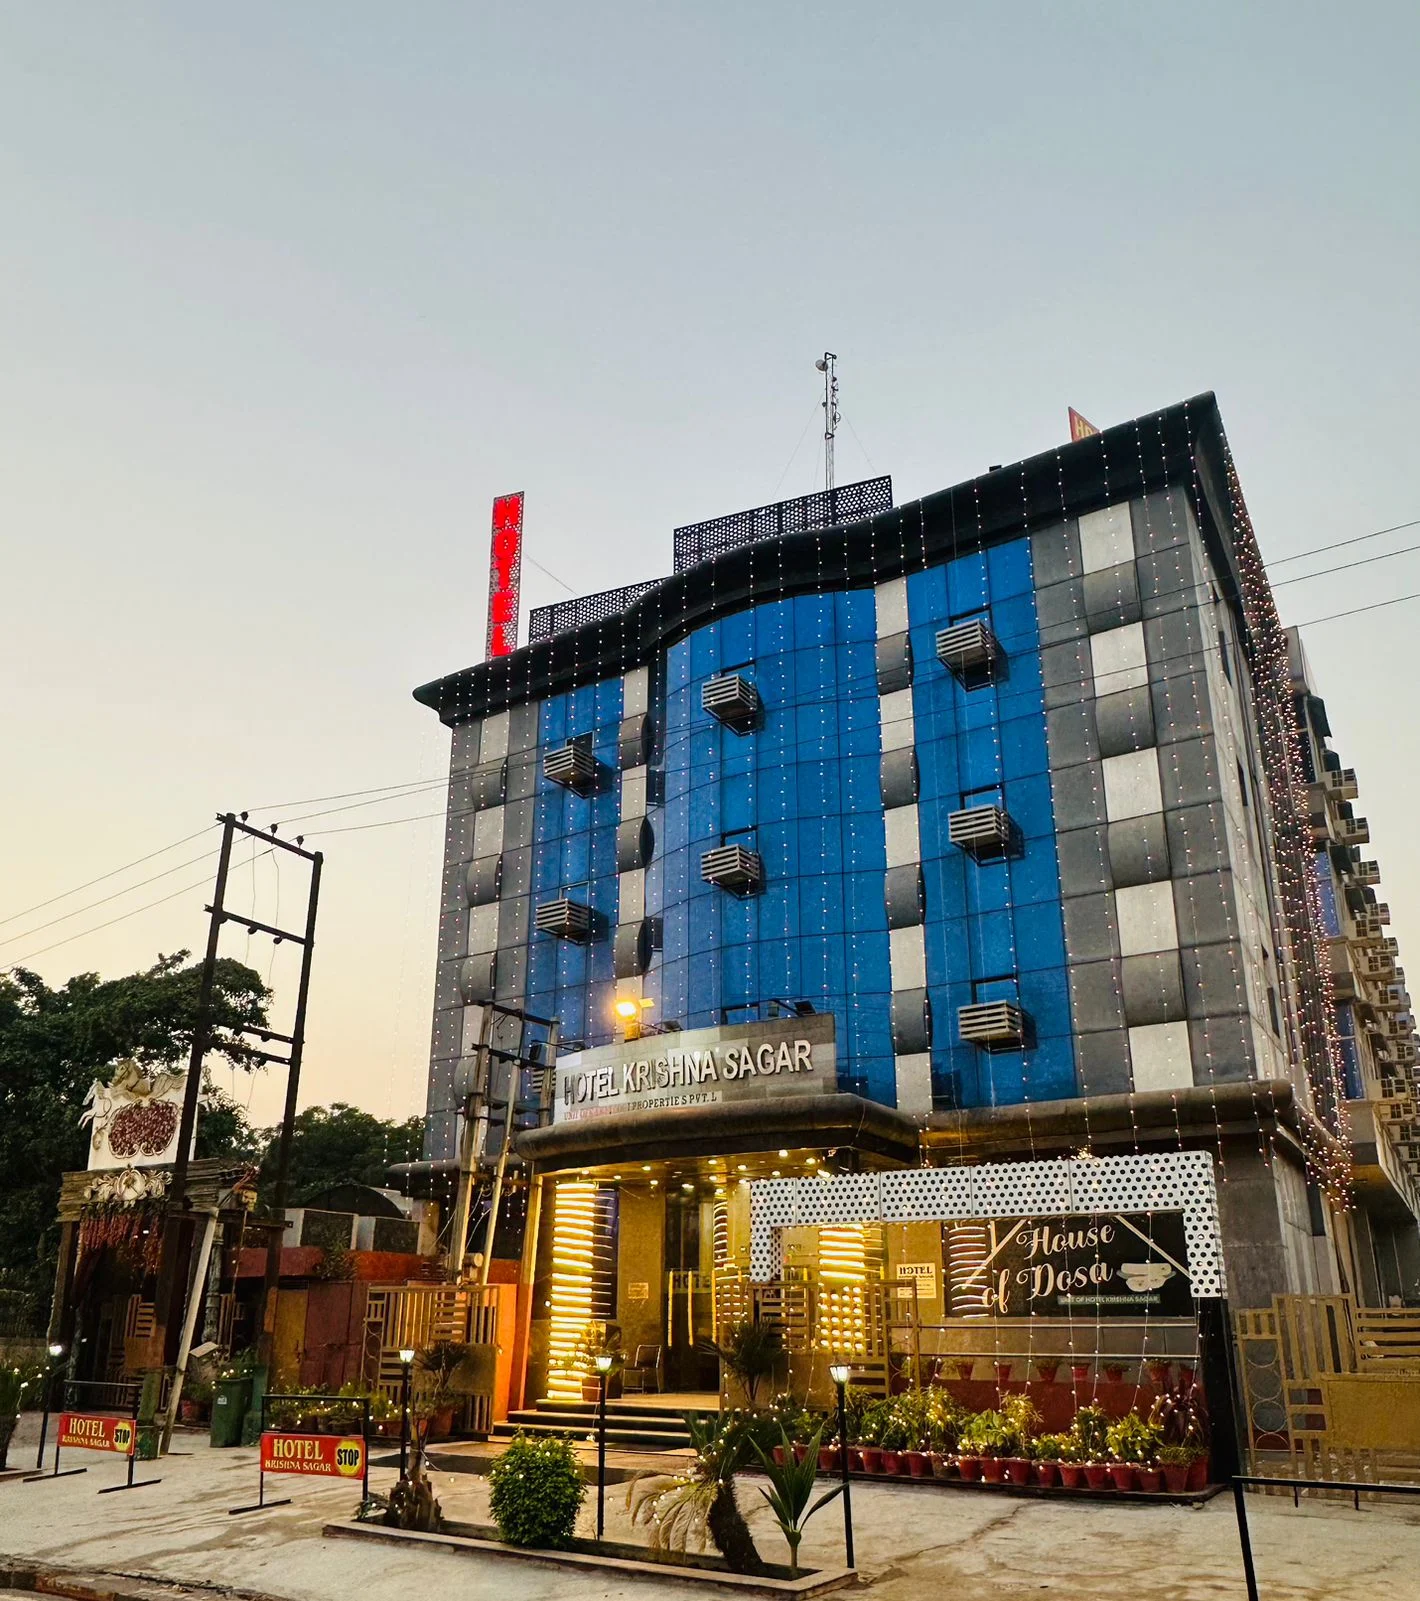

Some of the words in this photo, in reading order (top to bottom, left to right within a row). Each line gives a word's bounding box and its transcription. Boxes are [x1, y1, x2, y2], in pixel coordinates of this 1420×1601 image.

[491, 495, 521, 658] HOTEL
[563, 1066, 620, 1106] HOTEL
[623, 1050, 719, 1094] KRISHNA
[723, 1039, 814, 1081] SAGAR
[1015, 1223, 1116, 1261] House
[899, 1265, 933, 1275] HOTEL
[981, 1267, 1011, 1314] of
[1015, 1261, 1114, 1301] Dosa
[69, 1417, 106, 1438] HOTEL
[114, 1428, 131, 1444] STOP
[264, 1459, 301, 1471] KRISHNA
[302, 1461, 332, 1472] SAGAR
[273, 1438, 324, 1460] HOTEL
[337, 1448, 360, 1467] STOP
